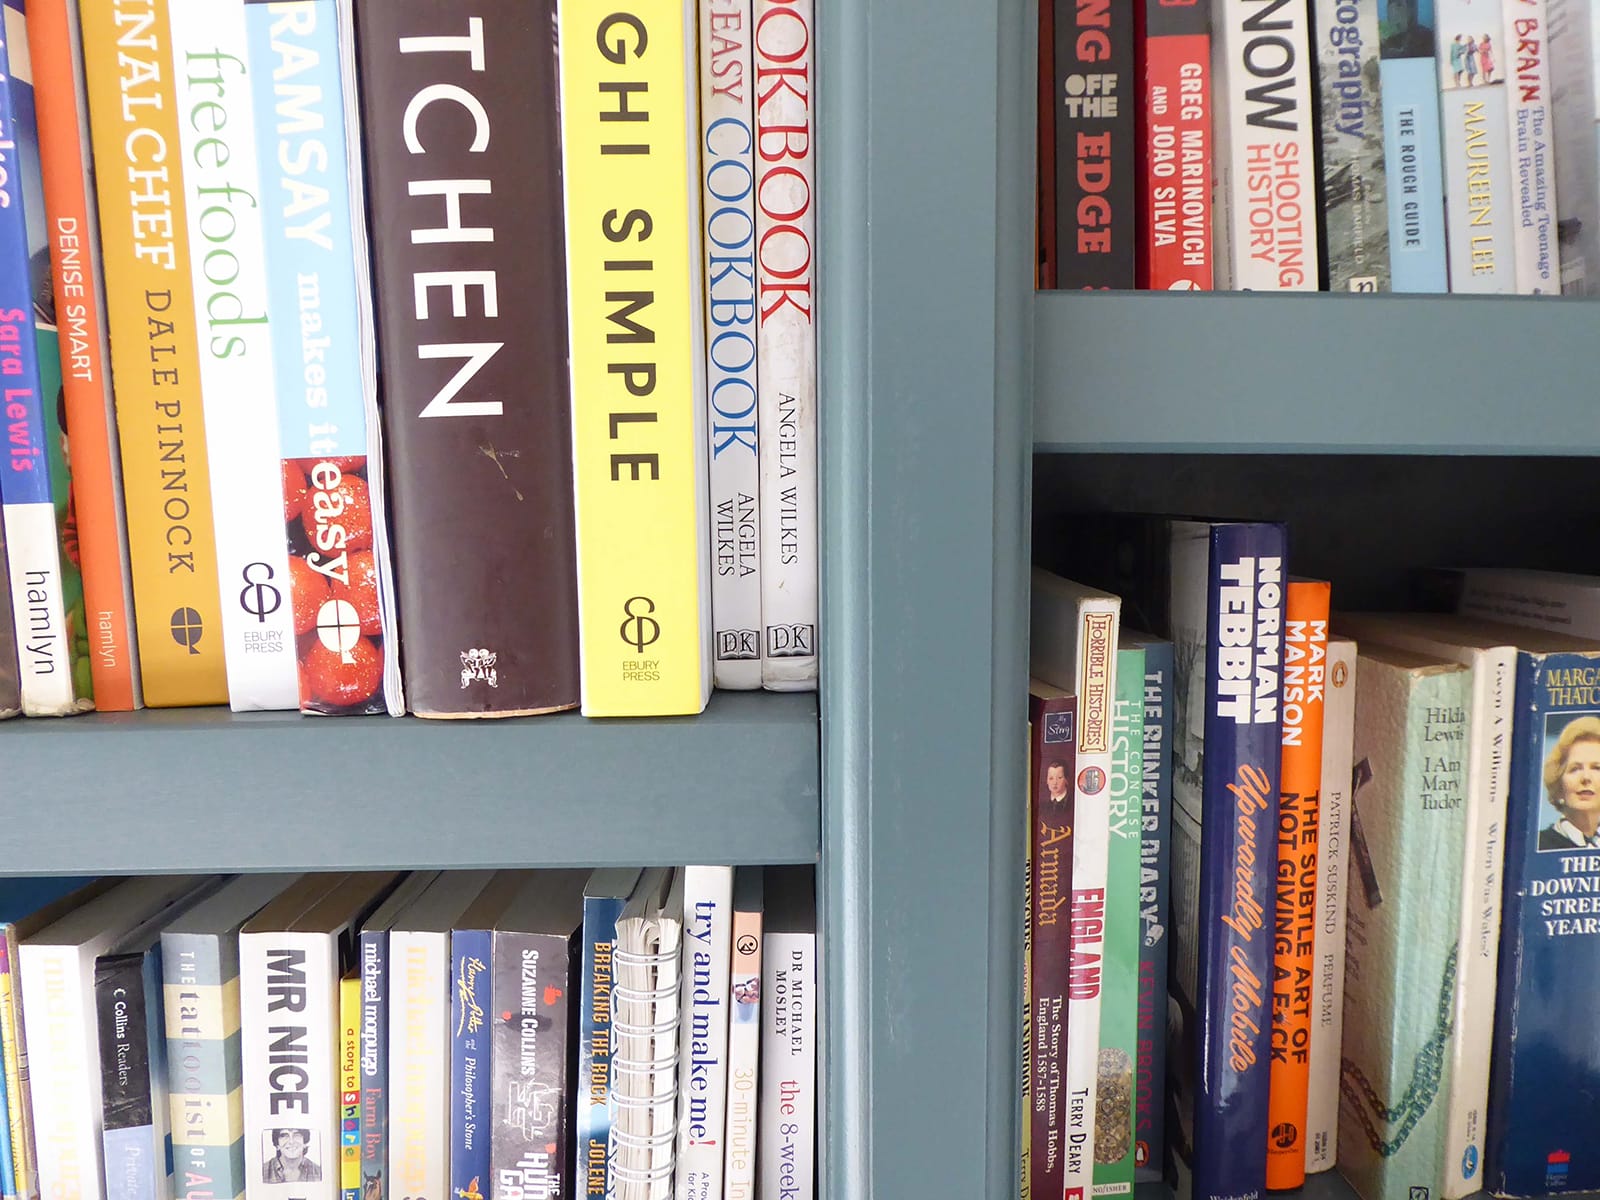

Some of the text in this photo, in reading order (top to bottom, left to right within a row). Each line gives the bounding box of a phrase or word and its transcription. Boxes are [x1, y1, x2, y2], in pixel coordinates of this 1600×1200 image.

[1065, 74, 1117, 96] OFF
[1065, 96, 1117, 118] THE
[1241, 0, 1298, 131] NOW
[1514, 18, 1541, 102] BRAIN
[185, 47, 270, 359] free foods
[399, 17, 505, 418] TCHEN
[756, 0, 811, 328] OKBOOK
[1077, 131, 1112, 253] EDGE
[1152, 85, 1176, 247] AND JOAO SILVA
[1180, 63, 1204, 266] GREG MARINOVICH
[1247, 144, 1275, 262] HISTORY
[1274, 142, 1304, 287] SHOOTING
[1400, 111, 1420, 247] THE ROUGH GUIDE
[1463, 101, 1495, 276] MAUREEN LEE
[1517, 108, 1533, 227] Brain Revealed
[1532, 105, 1550, 279] The Amazing Teenage
[596, 12, 659, 481] GHI SIMPLE
[706, 9, 756, 460] EASY COOKBOOK
[57, 217, 92, 381] DENISE SMART
[125, 128, 195, 573] CHEF DALE PINNOCK
[266, 1, 350, 587] RAMSAY makes it easy
[0, 308, 40, 471] Sara Lewis
[737, 492, 756, 578] ANGELA
[779, 392, 797, 565] ANGELA WILKES
[717, 499, 735, 577] WILKES
[25, 571, 57, 674] hamlyn
[98, 611, 118, 667] hamlyn
[244, 631, 283, 642] EBURY
[245, 642, 283, 653] PRESS
[622, 660, 660, 671] EBURY
[622, 671, 660, 681] PRESS
[722, 632, 754, 653] DK
[774, 625, 808, 650] DK
[1217, 557, 1255, 724] TEBBIT
[1254, 557, 1281, 724] NORMAN
[1307, 620, 1326, 704] MARK
[1087, 621, 1106, 746] HORRIBLE HISTORIES
[1144, 670, 1163, 719] THE
[1281, 620, 1306, 746] MANSON
[1424, 725, 1464, 742] Lewis
[1108, 700, 1129, 840] HISTORY
[1128, 701, 1142, 839] THE CONCISE
[1279, 792, 1299, 850] NOT
[1420, 793, 1462, 810] Tudor
[1422, 775, 1459, 793] Mary
[1424, 757, 1461, 772] I Am
[1490, 734, 1504, 804] Williams
[1038, 821, 1072, 926] Armada
[1485, 821, 1499, 870] When
[1559, 856, 1600, 874] THE
[1068, 887, 1105, 1000] ENGLAND
[1221, 764, 1271, 1073] Upwardly Mobile
[1274, 859, 1297, 955] GIVING
[1292, 790, 1319, 1064] THE SUBTLE ART OF
[1321, 791, 1342, 1026] PATRICK SUSKIND PERFUME
[1544, 918, 1600, 936] YEAR
[180, 951, 196, 984] THE
[521, 949, 539, 1076] SUZANNE COLLINS
[590, 942, 611, 1106] BREAKING THE ROCK
[686, 900, 720, 1146] try and make me!
[775, 970, 787, 1037] MOSLEY
[791, 950, 803, 1055] DR MICHAEL
[1274, 965, 1291, 982] A
[114, 1001, 131, 1086] Collins Readers
[179, 992, 212, 1137] tattooist
[266, 949, 309, 1115] MR NICE
[361, 943, 382, 1160] michael morpurgo Farm Boy
[1035, 998, 1050, 1112] England 1587-1588
[1045, 995, 1062, 1173] The Story Thomas Hobbs,
[1135, 961, 1154, 1131] KEVIN BROOKS
[343, 1028, 357, 1157] a story to share
[461, 1056, 477, 1150] Philosopher's Stone
[731, 1068, 754, 1170] 30-minute
[779, 1080, 800, 1200] the 8-week
[1067, 1088, 1089, 1174] TERRY DEARY
[190, 1148, 206, 1168] OF
[545, 1173, 560, 1197] THE
[587, 1139, 606, 1194] JOLENE
[688, 1172, 697, 1187] for
